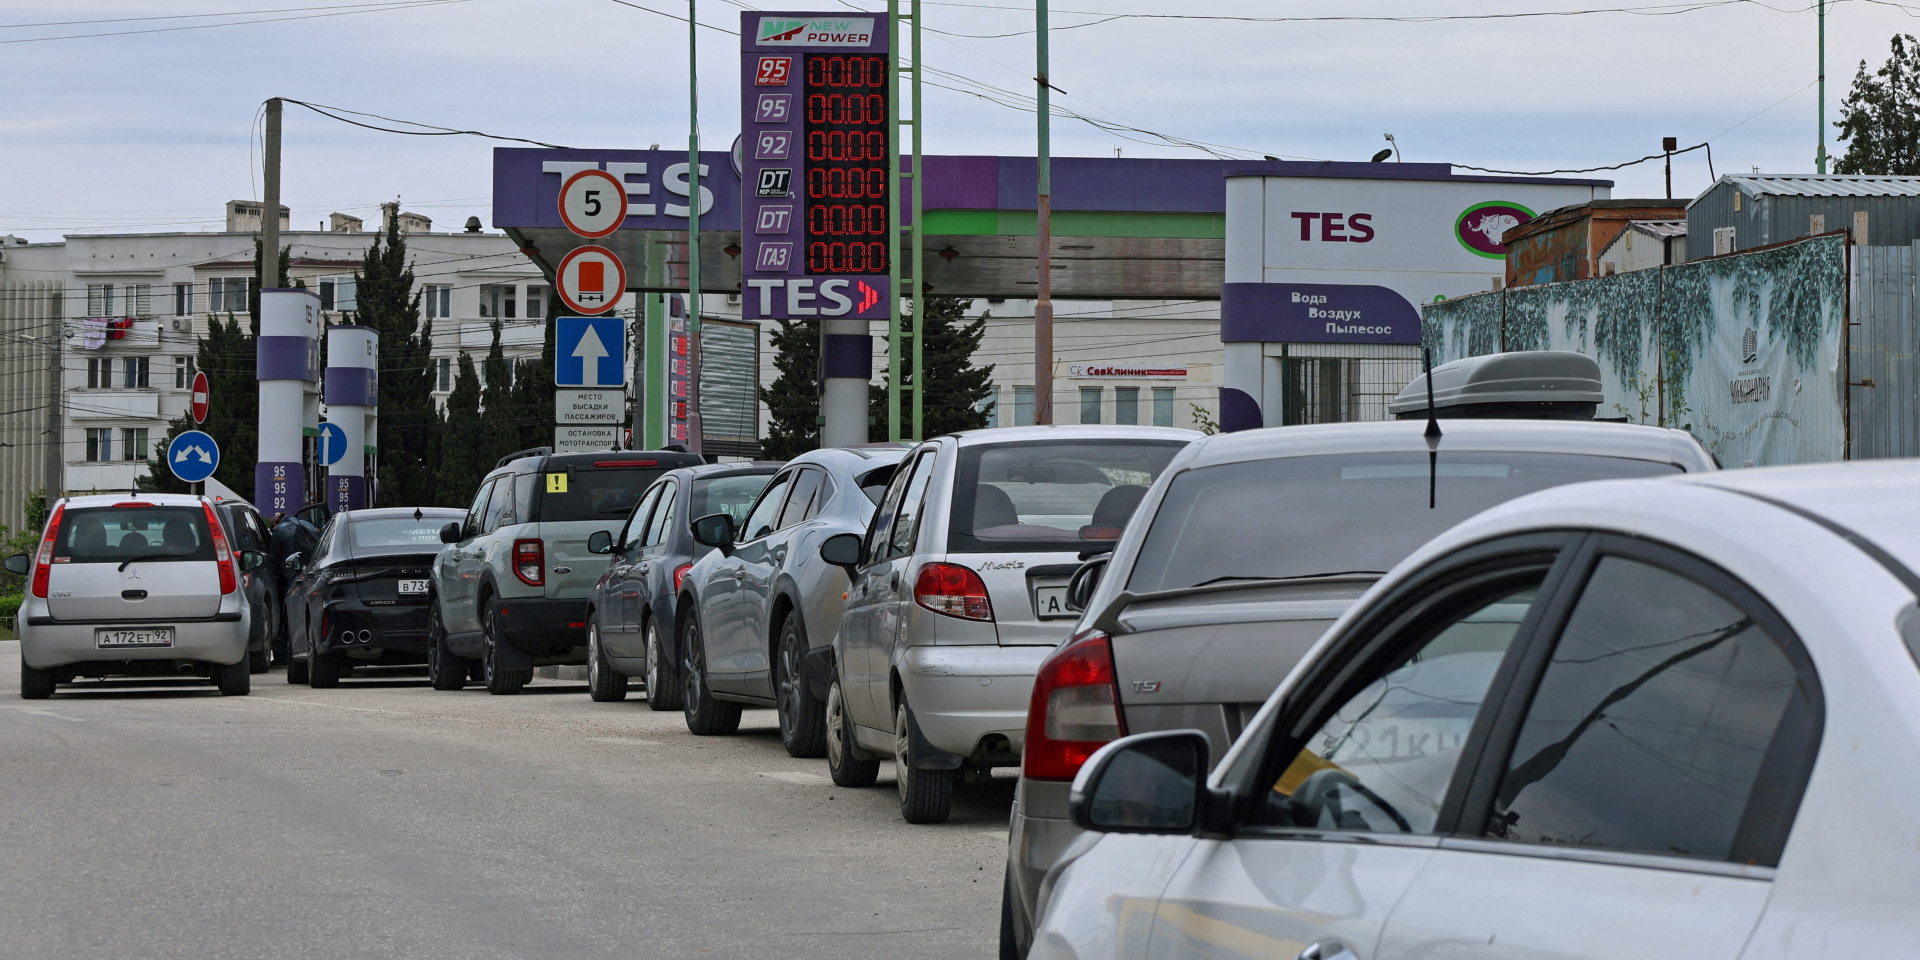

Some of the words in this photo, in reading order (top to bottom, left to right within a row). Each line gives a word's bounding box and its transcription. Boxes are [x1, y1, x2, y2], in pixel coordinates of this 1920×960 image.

[809, 21, 851, 31] NEW
[807, 33, 869, 43] POWER
[761, 60, 787, 77] 95
[808, 56, 884, 87] 00.00
[761, 99, 787, 117] 95
[808, 93, 884, 124] 00.00
[761, 136, 787, 154] 92
[808, 130, 884, 161] 00.00
[760, 171, 789, 189] DT
[808, 167, 884, 198] 00.00
[584, 190, 602, 216] 5
[760, 211, 788, 229] DT
[809, 204, 885, 235] 00.00
[1291, 211, 1375, 243] TES
[762, 248, 787, 265] ГАЗ
[809, 241, 885, 272] 00.00
[747, 278, 853, 316] TES
[1291, 292, 1327, 305] Вода
[1308, 307, 1361, 321] Воздух
[1325, 322, 1392, 334] Пылесос
[273, 465, 285, 477] 95
[274, 482, 286, 494] 95
[339, 478, 349, 488] 95
[274, 497, 285, 509] 92
[339, 492, 349, 502] 95
[977, 561, 1024, 572] Matiz
[154, 630, 167, 640] 92
